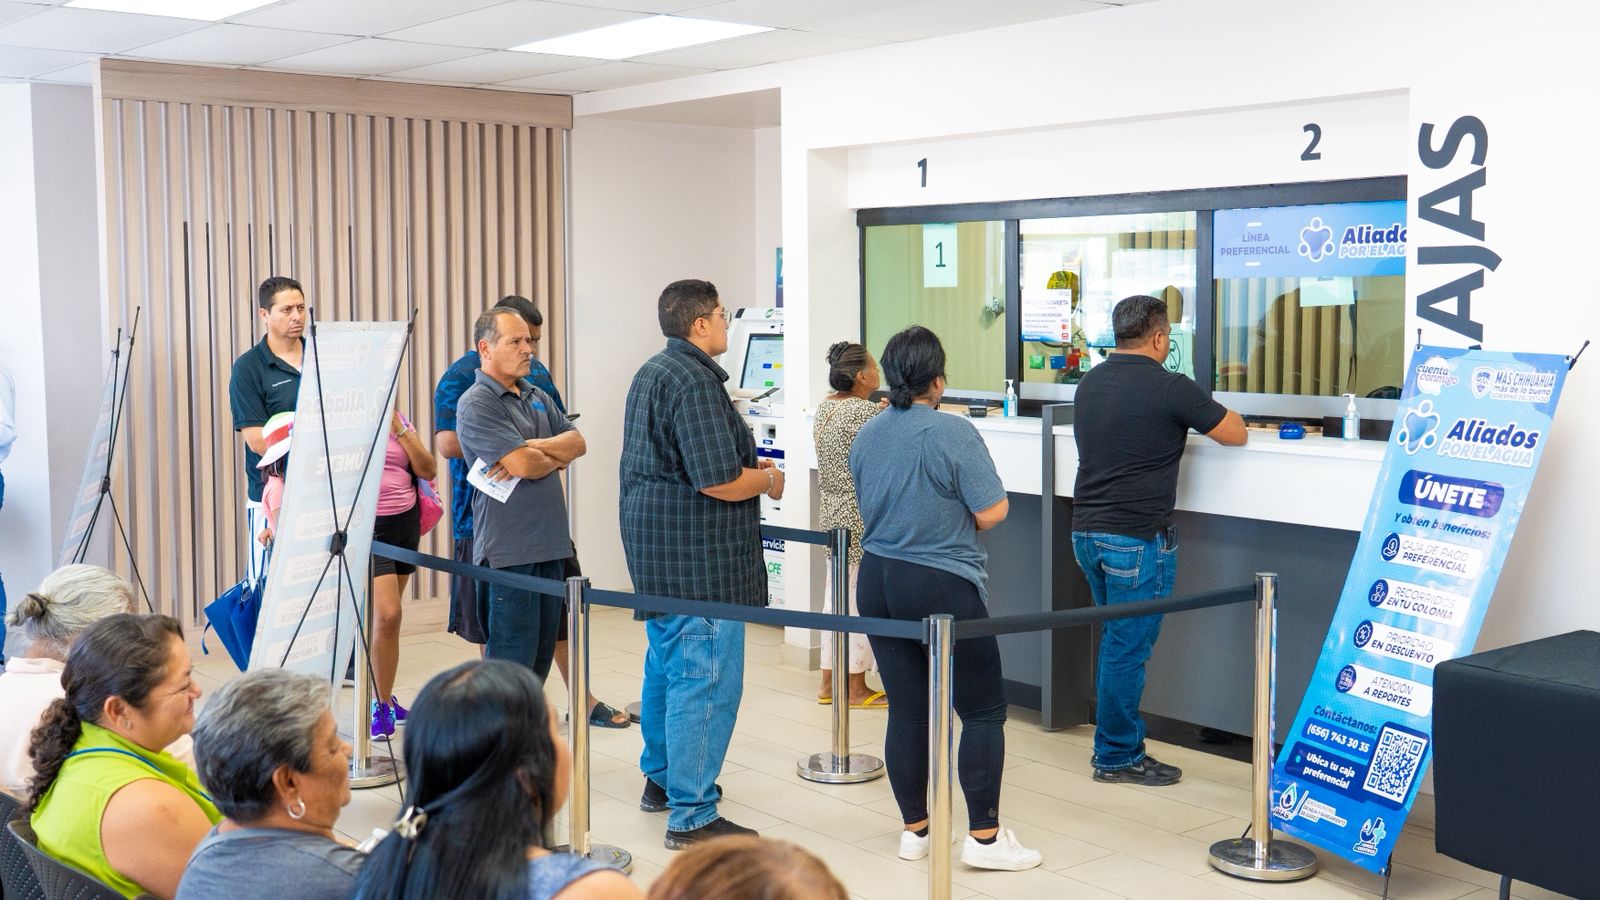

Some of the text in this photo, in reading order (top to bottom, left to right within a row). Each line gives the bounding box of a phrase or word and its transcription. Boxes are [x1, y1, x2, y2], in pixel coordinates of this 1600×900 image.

[1300, 122, 1322, 161] 2
[917, 158, 927, 188] 1
[1242, 231, 1270, 243] LÍNEA
[1342, 224, 1406, 245] Aliad
[1416, 114, 1502, 350] AJAS
[935, 241, 946, 268] 1
[1220, 245, 1290, 257] PREFERENCIAL
[1341, 245, 1366, 257] POR
[1384, 244, 1406, 256] AG
[1417, 364, 1449, 376] cuenta
[1419, 373, 1458, 386] conmigo
[1513, 372, 1554, 389] CHIHUAHUA
[1446, 420, 1539, 449] Aliados
[1441, 441, 1471, 458] POR
[1490, 446, 1532, 465] AGUA
[1414, 475, 1487, 509] ÚNETE
[1394, 512, 1402, 522] Y
[1402, 540, 1470, 562] CAJA DE PAGO
[1402, 551, 1466, 574] PREFERENCIAL
[768, 562, 782, 574] CFE
[1386, 597, 1453, 620] EN TU COLONIA
[1395, 586, 1457, 609] RECORRIDOS
[1371, 639, 1434, 663] EN DESCUENTO
[1385, 631, 1434, 652] PRIORIDAD
[1363, 686, 1412, 707] A REPORTES
[1313, 705, 1378, 734] Contáctanos:
[1307, 723, 1370, 753] (656) 743 30 35
[1306, 752, 1356, 778] Ubica tu caja
[1302, 765, 1350, 790] preferencial
